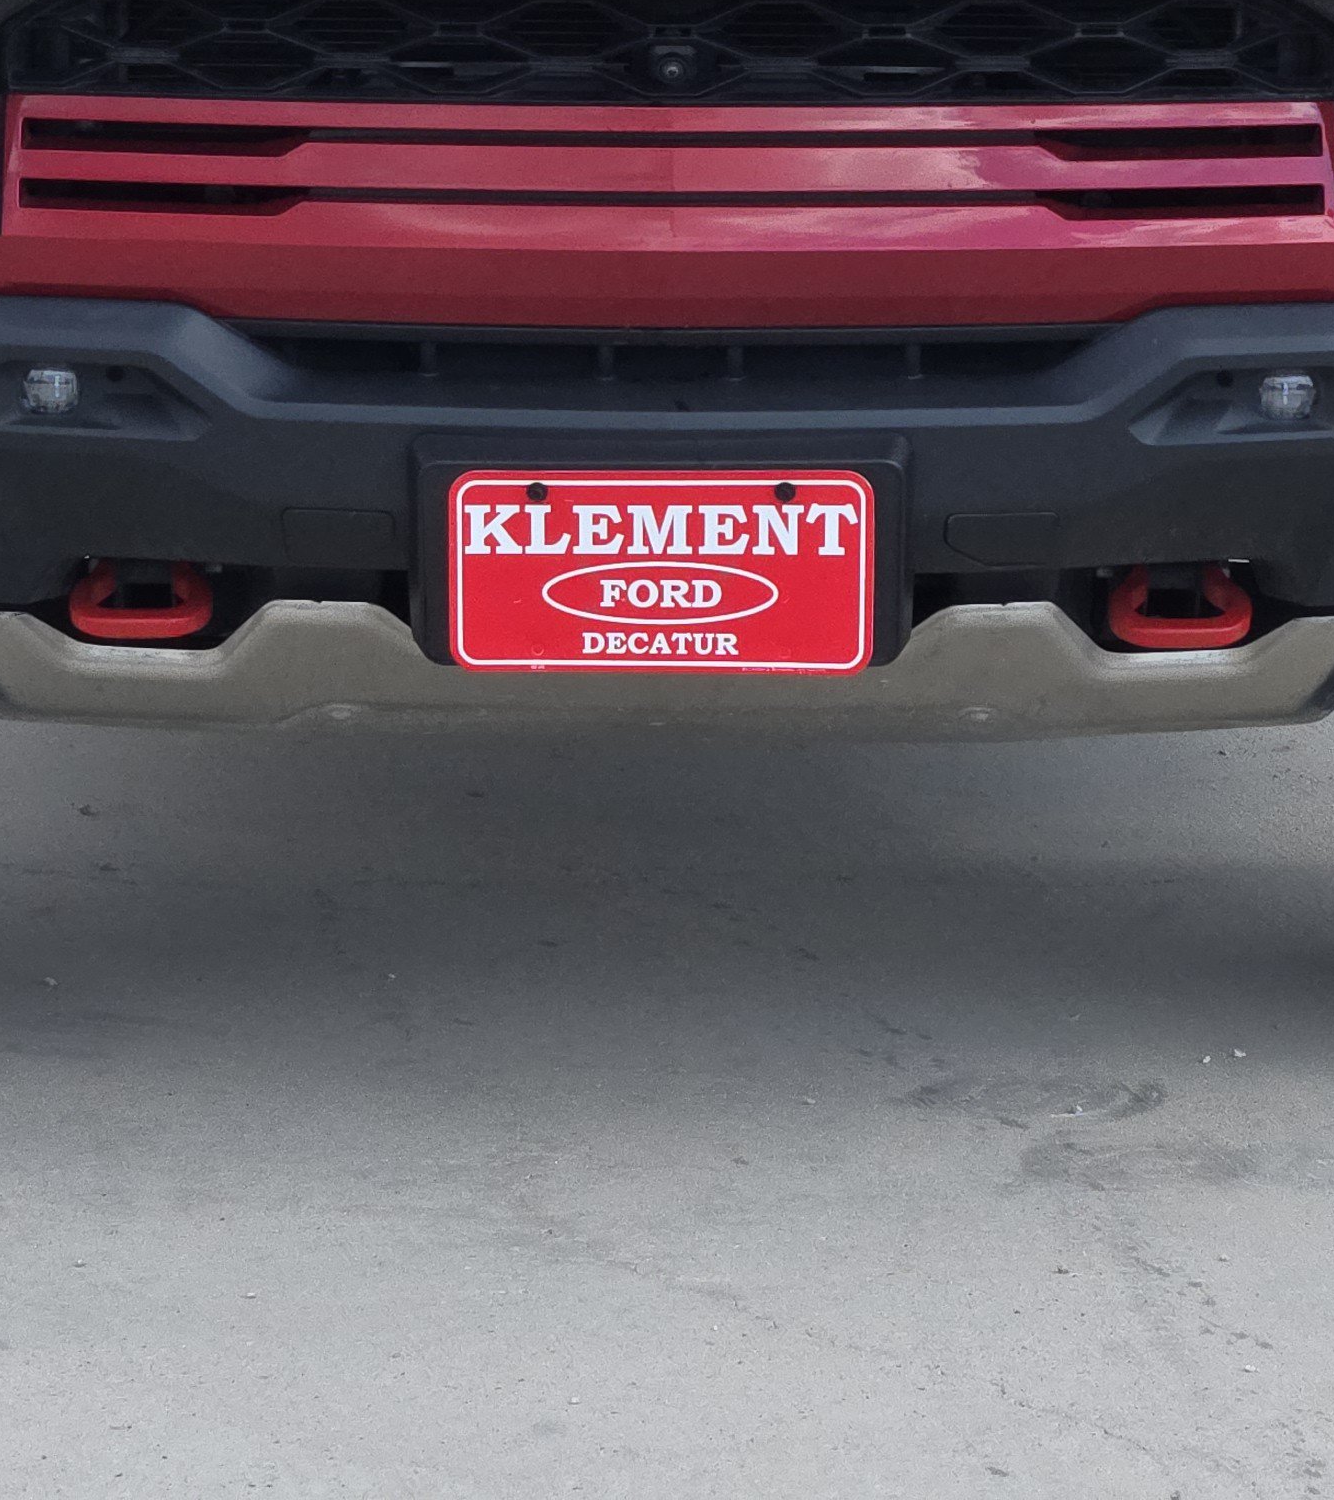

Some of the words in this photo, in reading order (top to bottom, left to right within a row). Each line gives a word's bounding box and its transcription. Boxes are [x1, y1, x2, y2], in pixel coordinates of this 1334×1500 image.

[464, 503, 858, 556] KLEMENT
[599, 579, 723, 609] FORD
[581, 632, 739, 656] DECATUR
